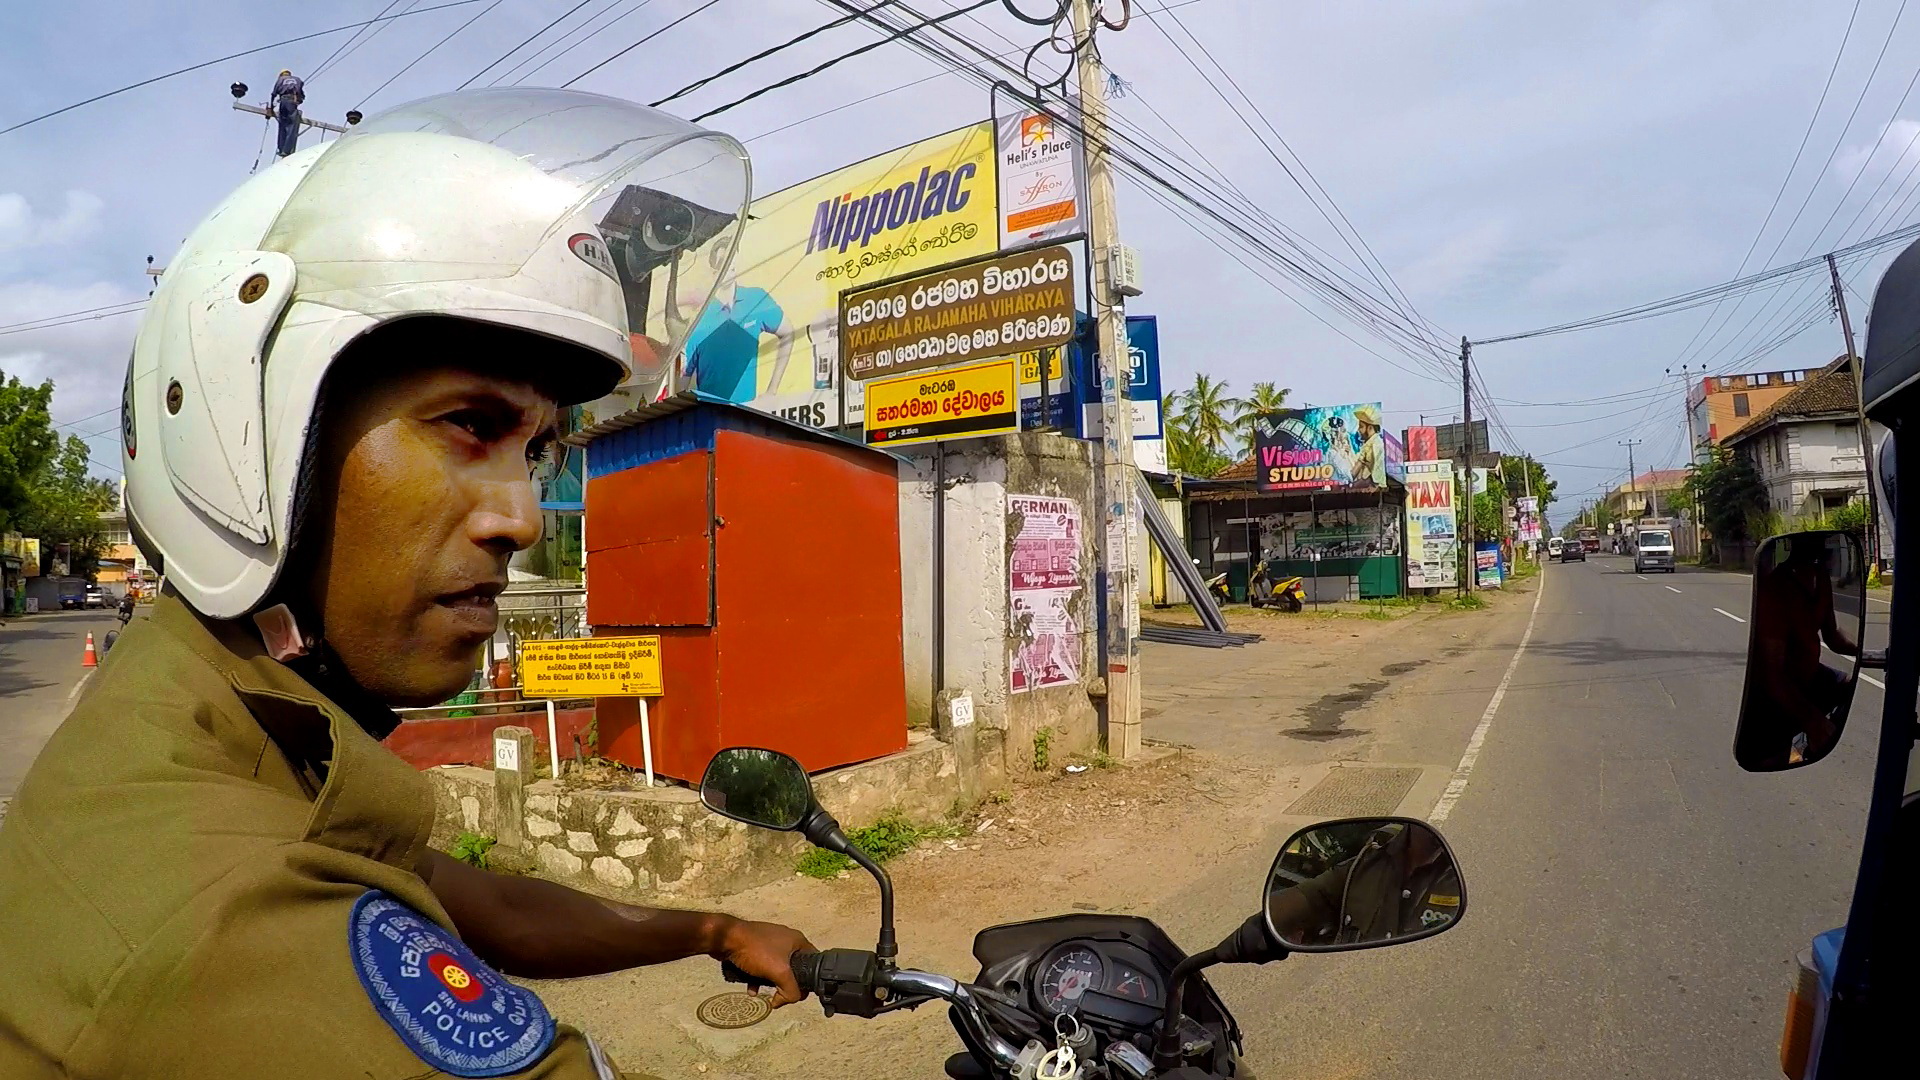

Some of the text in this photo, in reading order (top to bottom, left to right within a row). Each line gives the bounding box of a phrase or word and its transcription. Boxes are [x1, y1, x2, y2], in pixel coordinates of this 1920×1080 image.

[1007, 140, 1072, 166] Heli's Place
[805, 162, 977, 255] Nippolac
[846, 258, 1069, 327] යටගල රජමහ විහාරය
[847, 317, 913, 349] YATAGALA
[914, 303, 989, 334] RAJAMAHA
[990, 287, 1066, 321] VIHARAYA
[972, 326, 1000, 350] මහ
[876, 398, 938, 422] සතරමහා
[941, 389, 1006, 417] දේවාලය
[1261, 445, 1323, 467] Vision
[1269, 464, 1335, 483] STUDIO
[1011, 500, 1069, 515] GERMAN
[1408, 480, 1451, 509] TAXI
[437, 990, 457, 1011] SRI
[456, 1007, 494, 1024] LANKA
[421, 1000, 510, 1049] POLICE
